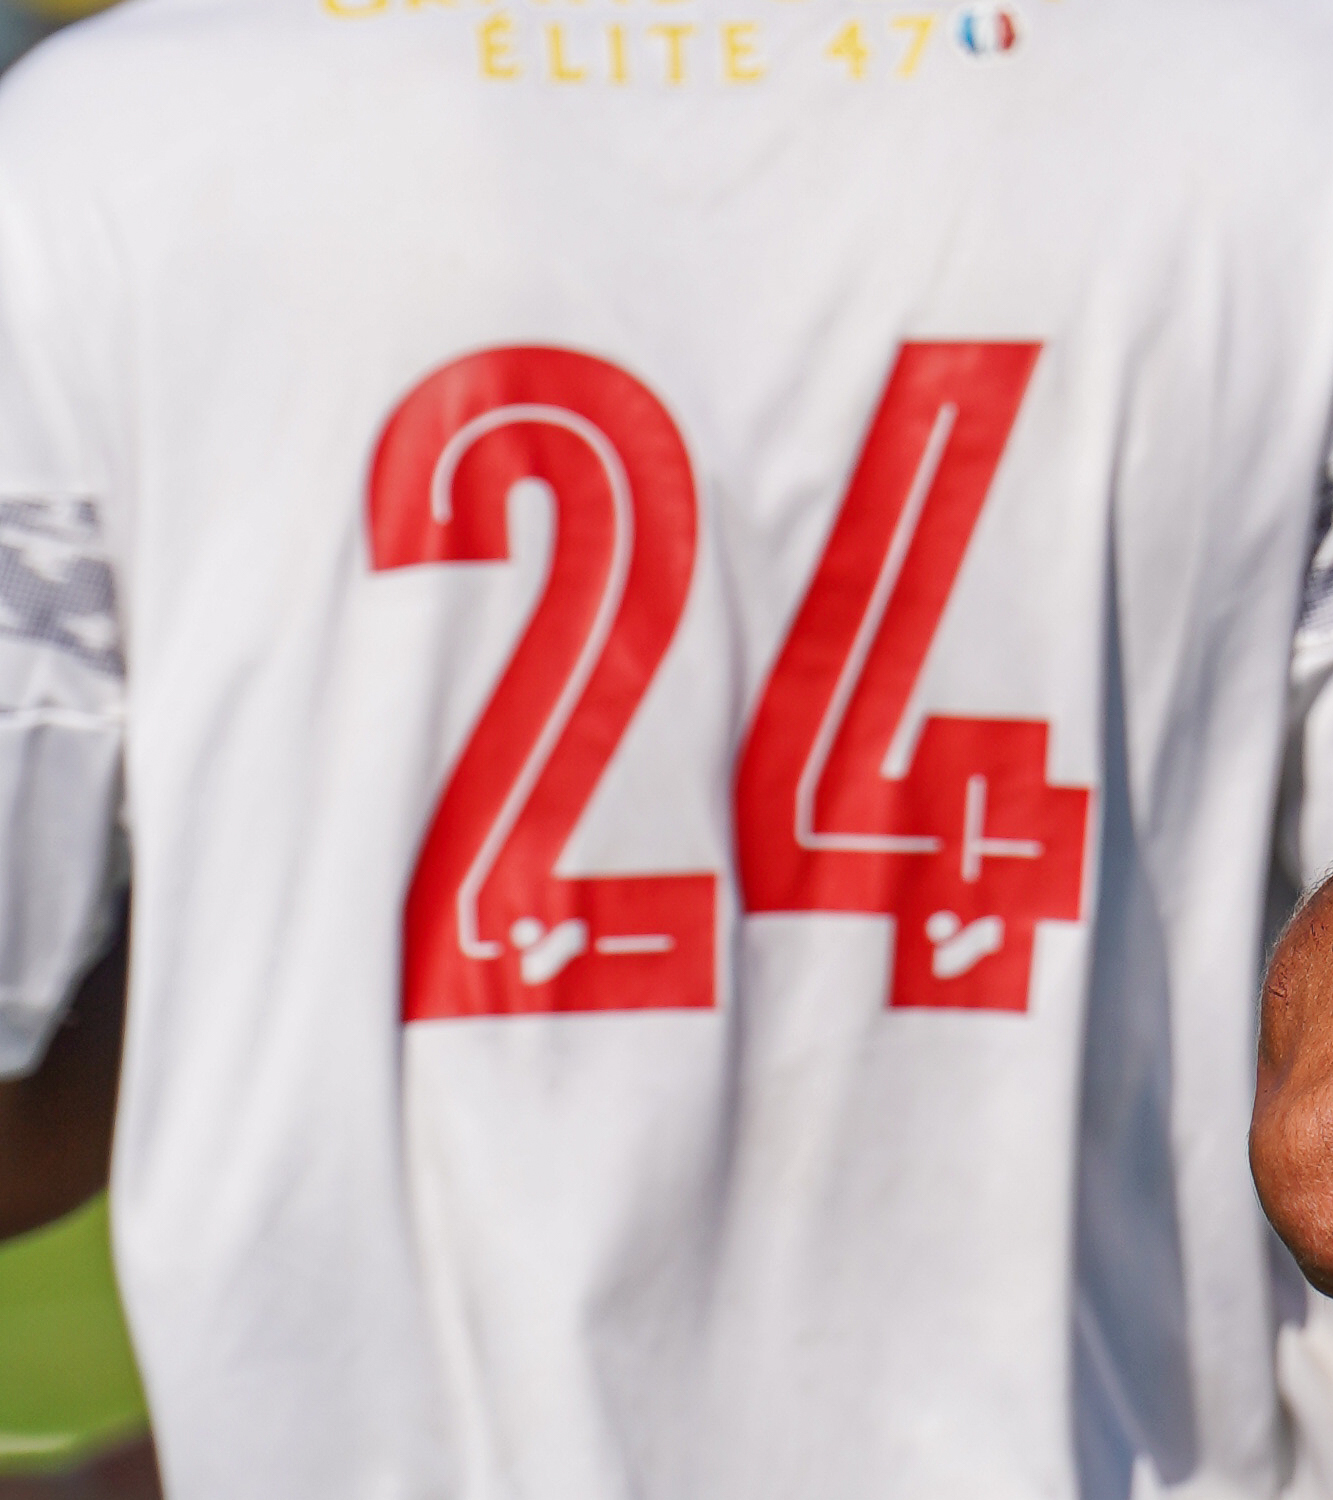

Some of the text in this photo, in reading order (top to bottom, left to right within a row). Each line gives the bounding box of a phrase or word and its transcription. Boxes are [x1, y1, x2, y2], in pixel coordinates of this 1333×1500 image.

[478, 10, 937, 85] ÉLITE 47
[365, 340, 1095, 1024] 24
